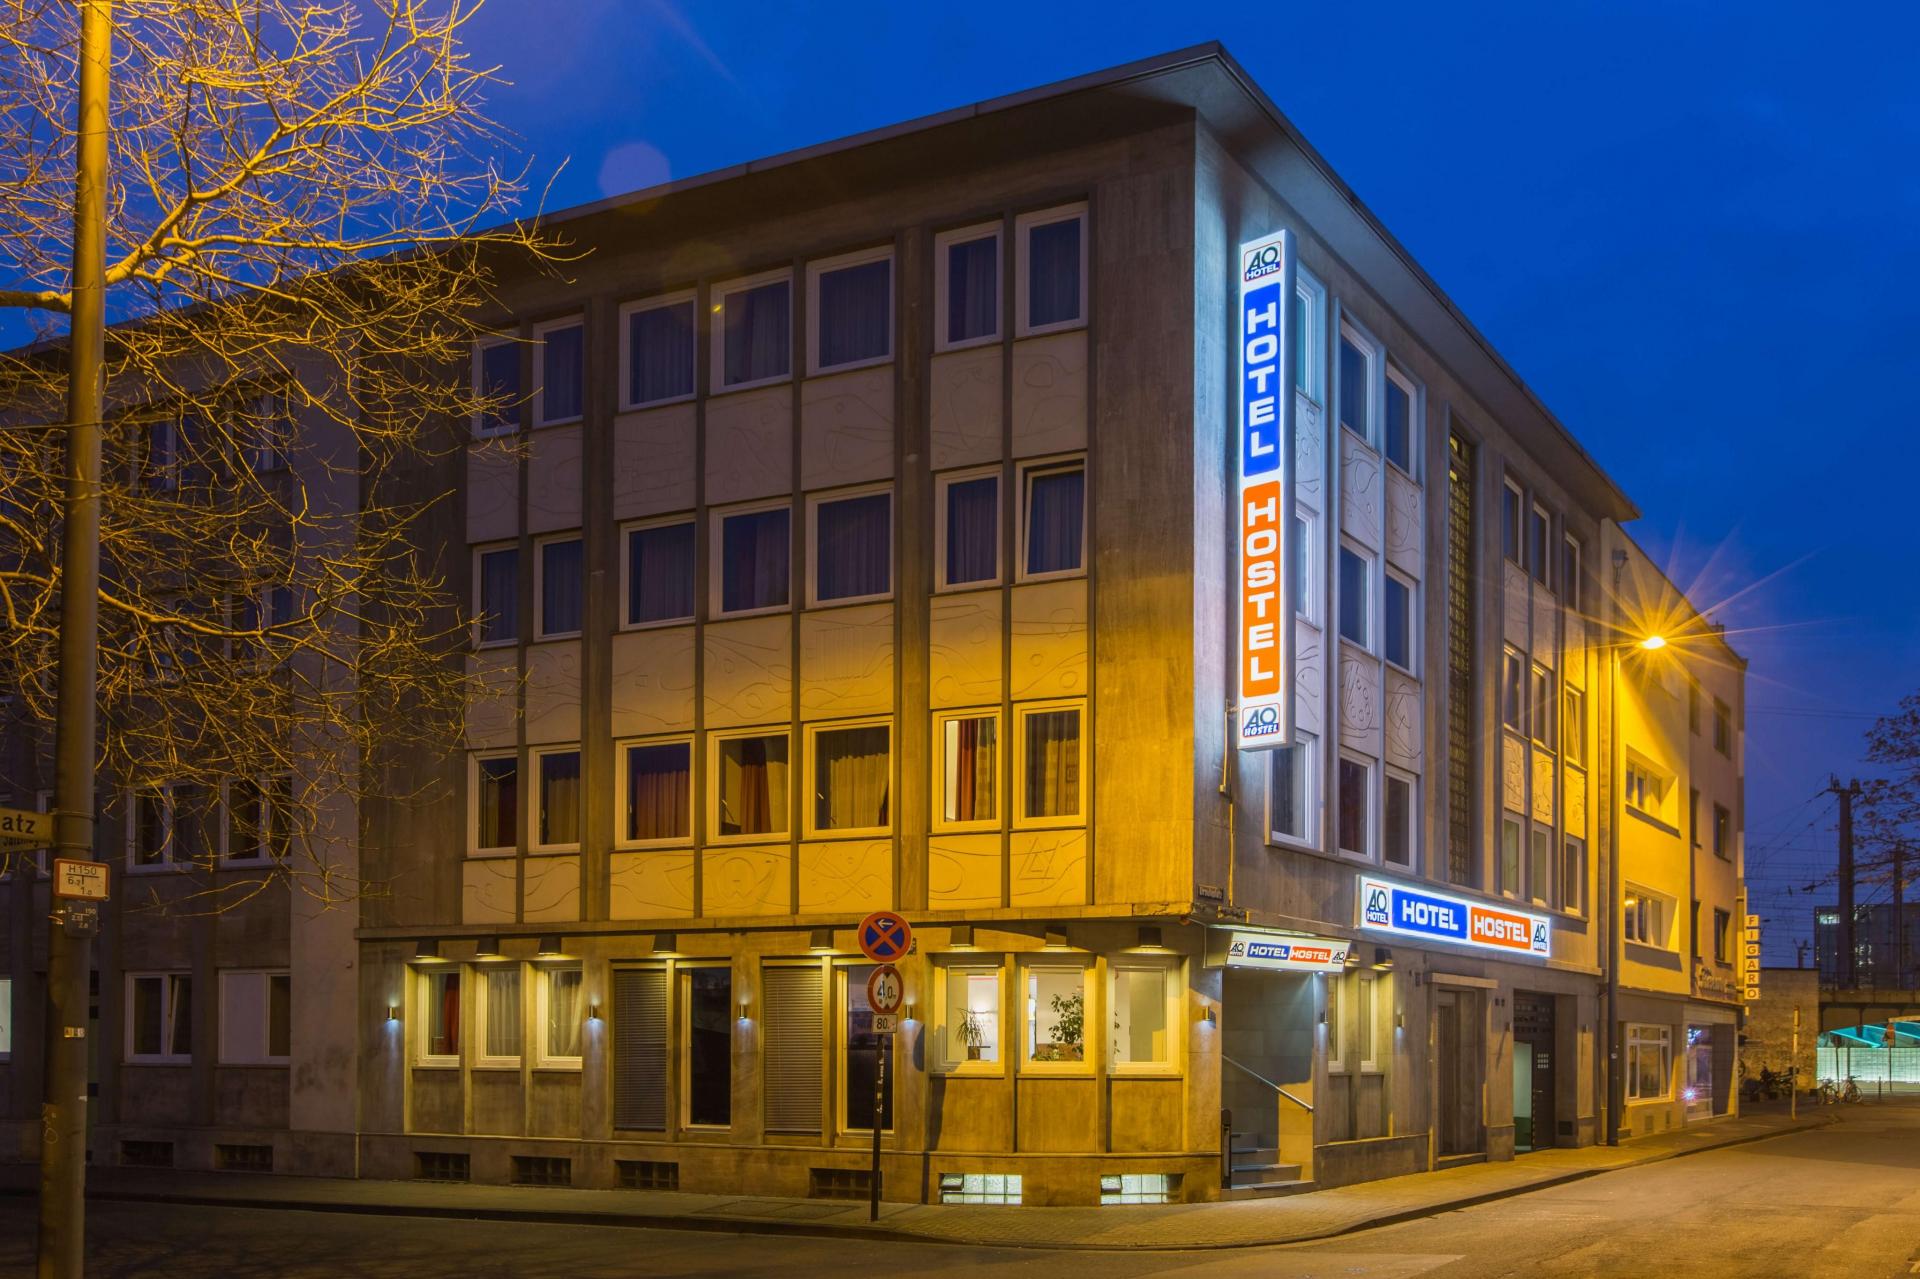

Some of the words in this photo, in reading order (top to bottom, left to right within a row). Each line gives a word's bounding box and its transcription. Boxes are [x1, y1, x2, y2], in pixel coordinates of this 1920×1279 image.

[1246, 263, 1278, 280] HOTEL
[1246, 302, 1278, 457] HOTEL
[1246, 497, 1278, 682] HOSTEL
[1244, 724, 1278, 737] HOSTEL
[2, 814, 35, 834] atz
[1367, 910, 1388, 924] HOTEL
[1402, 899, 1459, 931] HOTEL
[1474, 914, 1529, 943] HOSTEL
[1249, 946, 1287, 957] HOTEL
[1290, 949, 1330, 960] HOSTEL
[1746, 916, 1757, 998] FIGARO
